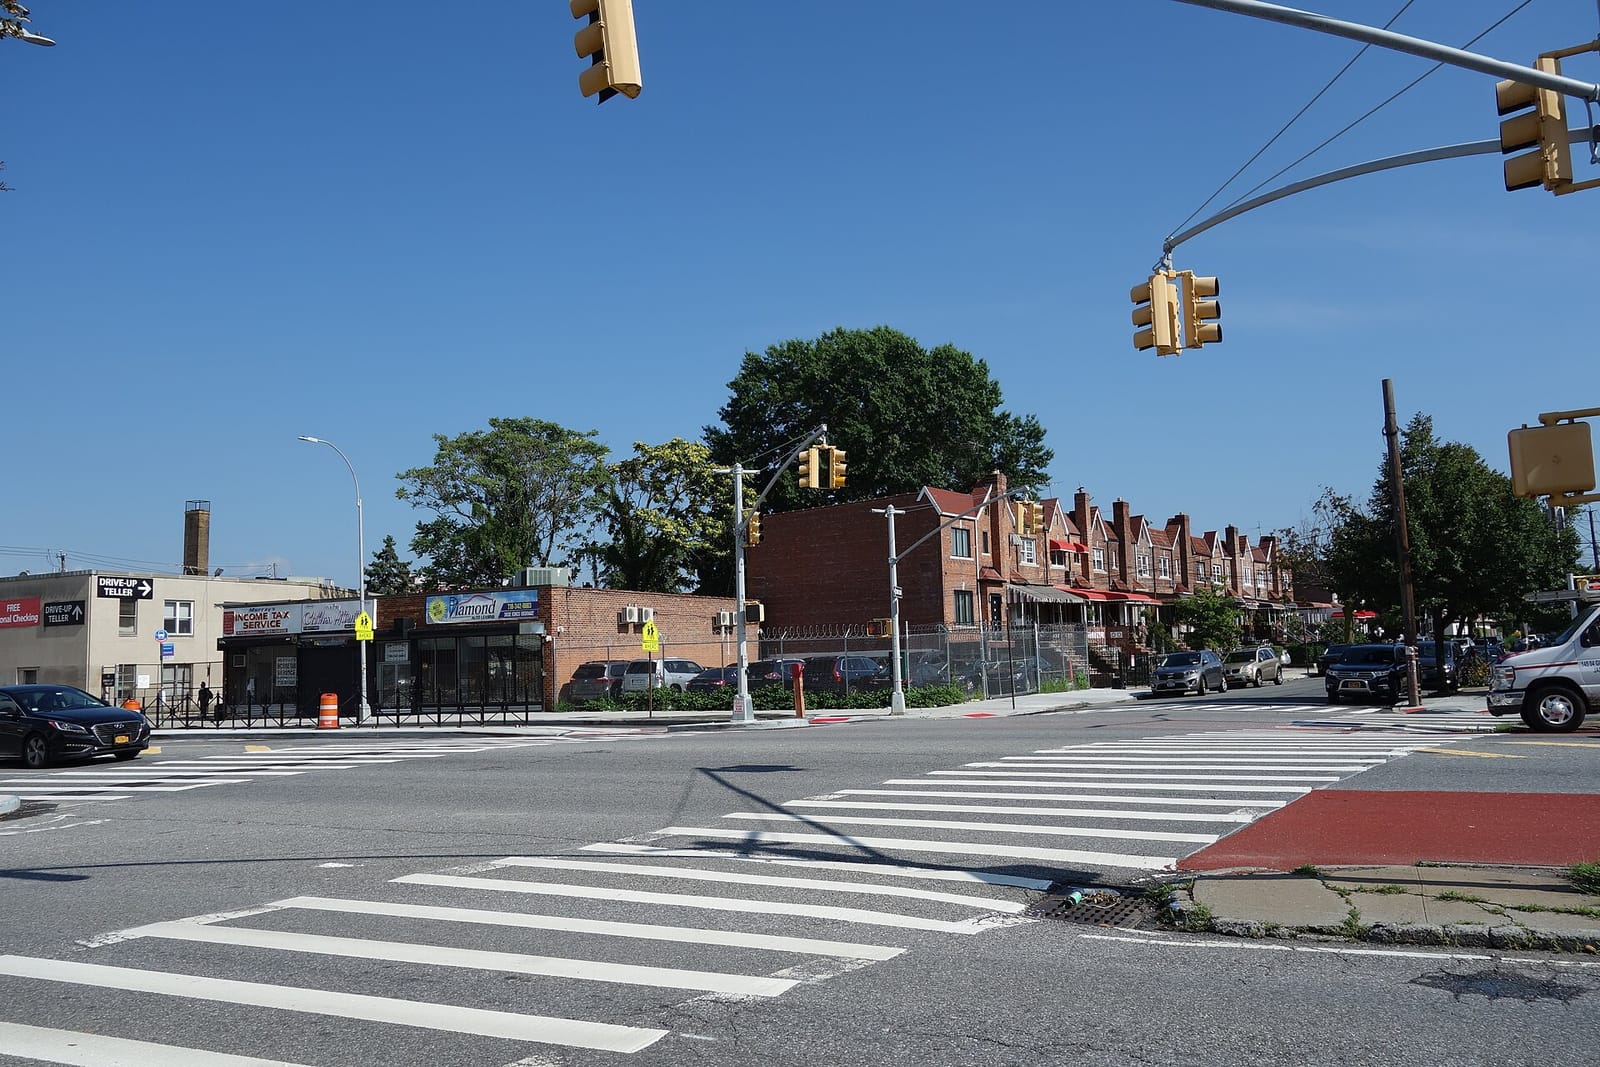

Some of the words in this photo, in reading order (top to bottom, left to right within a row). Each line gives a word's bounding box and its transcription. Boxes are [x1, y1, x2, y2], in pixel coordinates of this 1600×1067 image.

[99, 578, 138, 587] DRIVE-UP
[104, 587, 133, 596] TELLER
[6, 603, 21, 612] FREE
[45, 605, 73, 614] DRIVE-UP
[449, 597, 497, 618] Diamond
[13, 613, 39, 624] Checking
[48, 614, 69, 623] TELLER
[235, 612, 268, 621] INCOME
[272, 611, 290, 619] TAX
[243, 620, 281, 629] SERVICE
